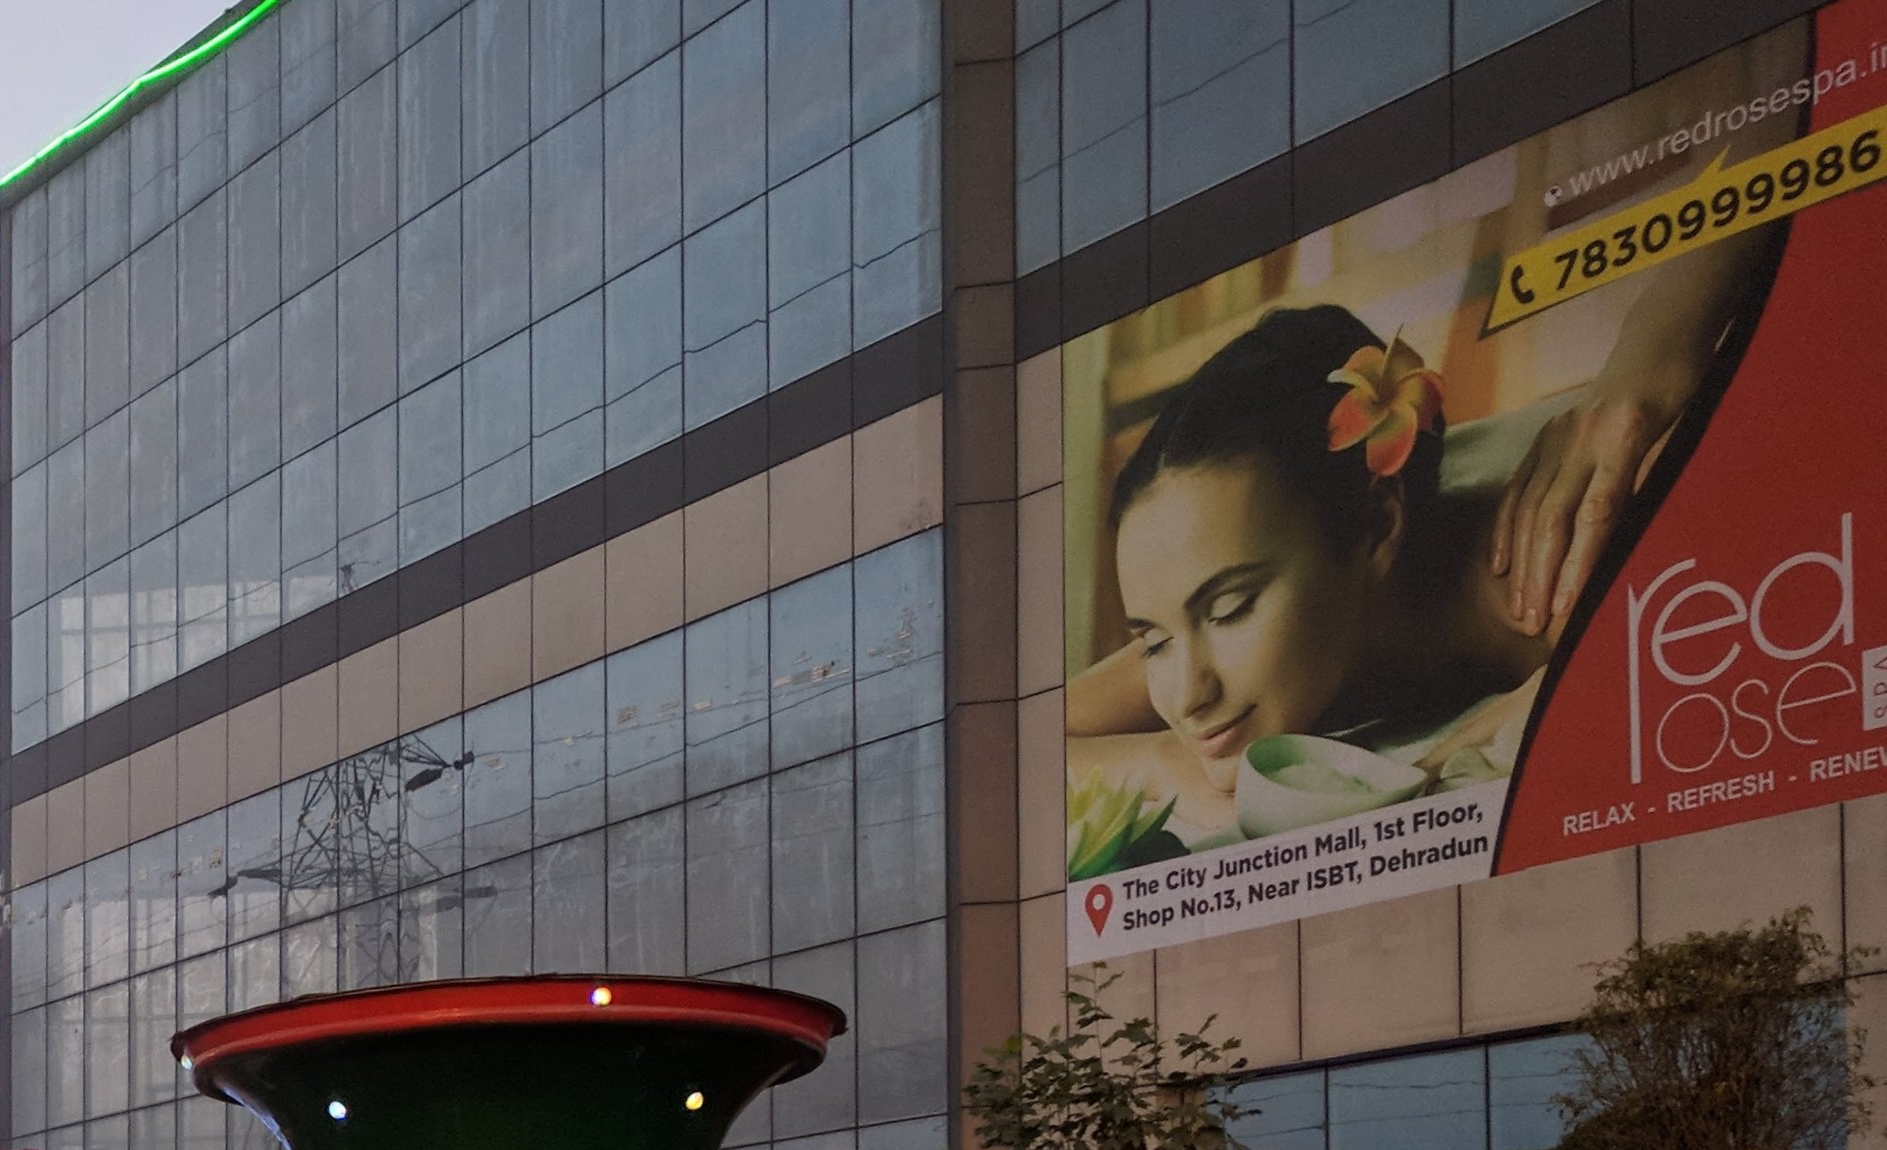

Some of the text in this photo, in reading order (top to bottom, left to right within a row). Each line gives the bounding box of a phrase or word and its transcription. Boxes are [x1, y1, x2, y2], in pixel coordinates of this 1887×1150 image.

[1554, 129, 1882, 292] 7830999986
[1628, 511, 1854, 785] red
[1122, 802, 1483, 900] The City Junction Mall, 1st Floor,
[1563, 802, 1636, 836] RELAX
[1667, 770, 1775, 814] REFRESH
[1122, 835, 1489, 931] Shop No.13, Near ISBT, Dehradun
